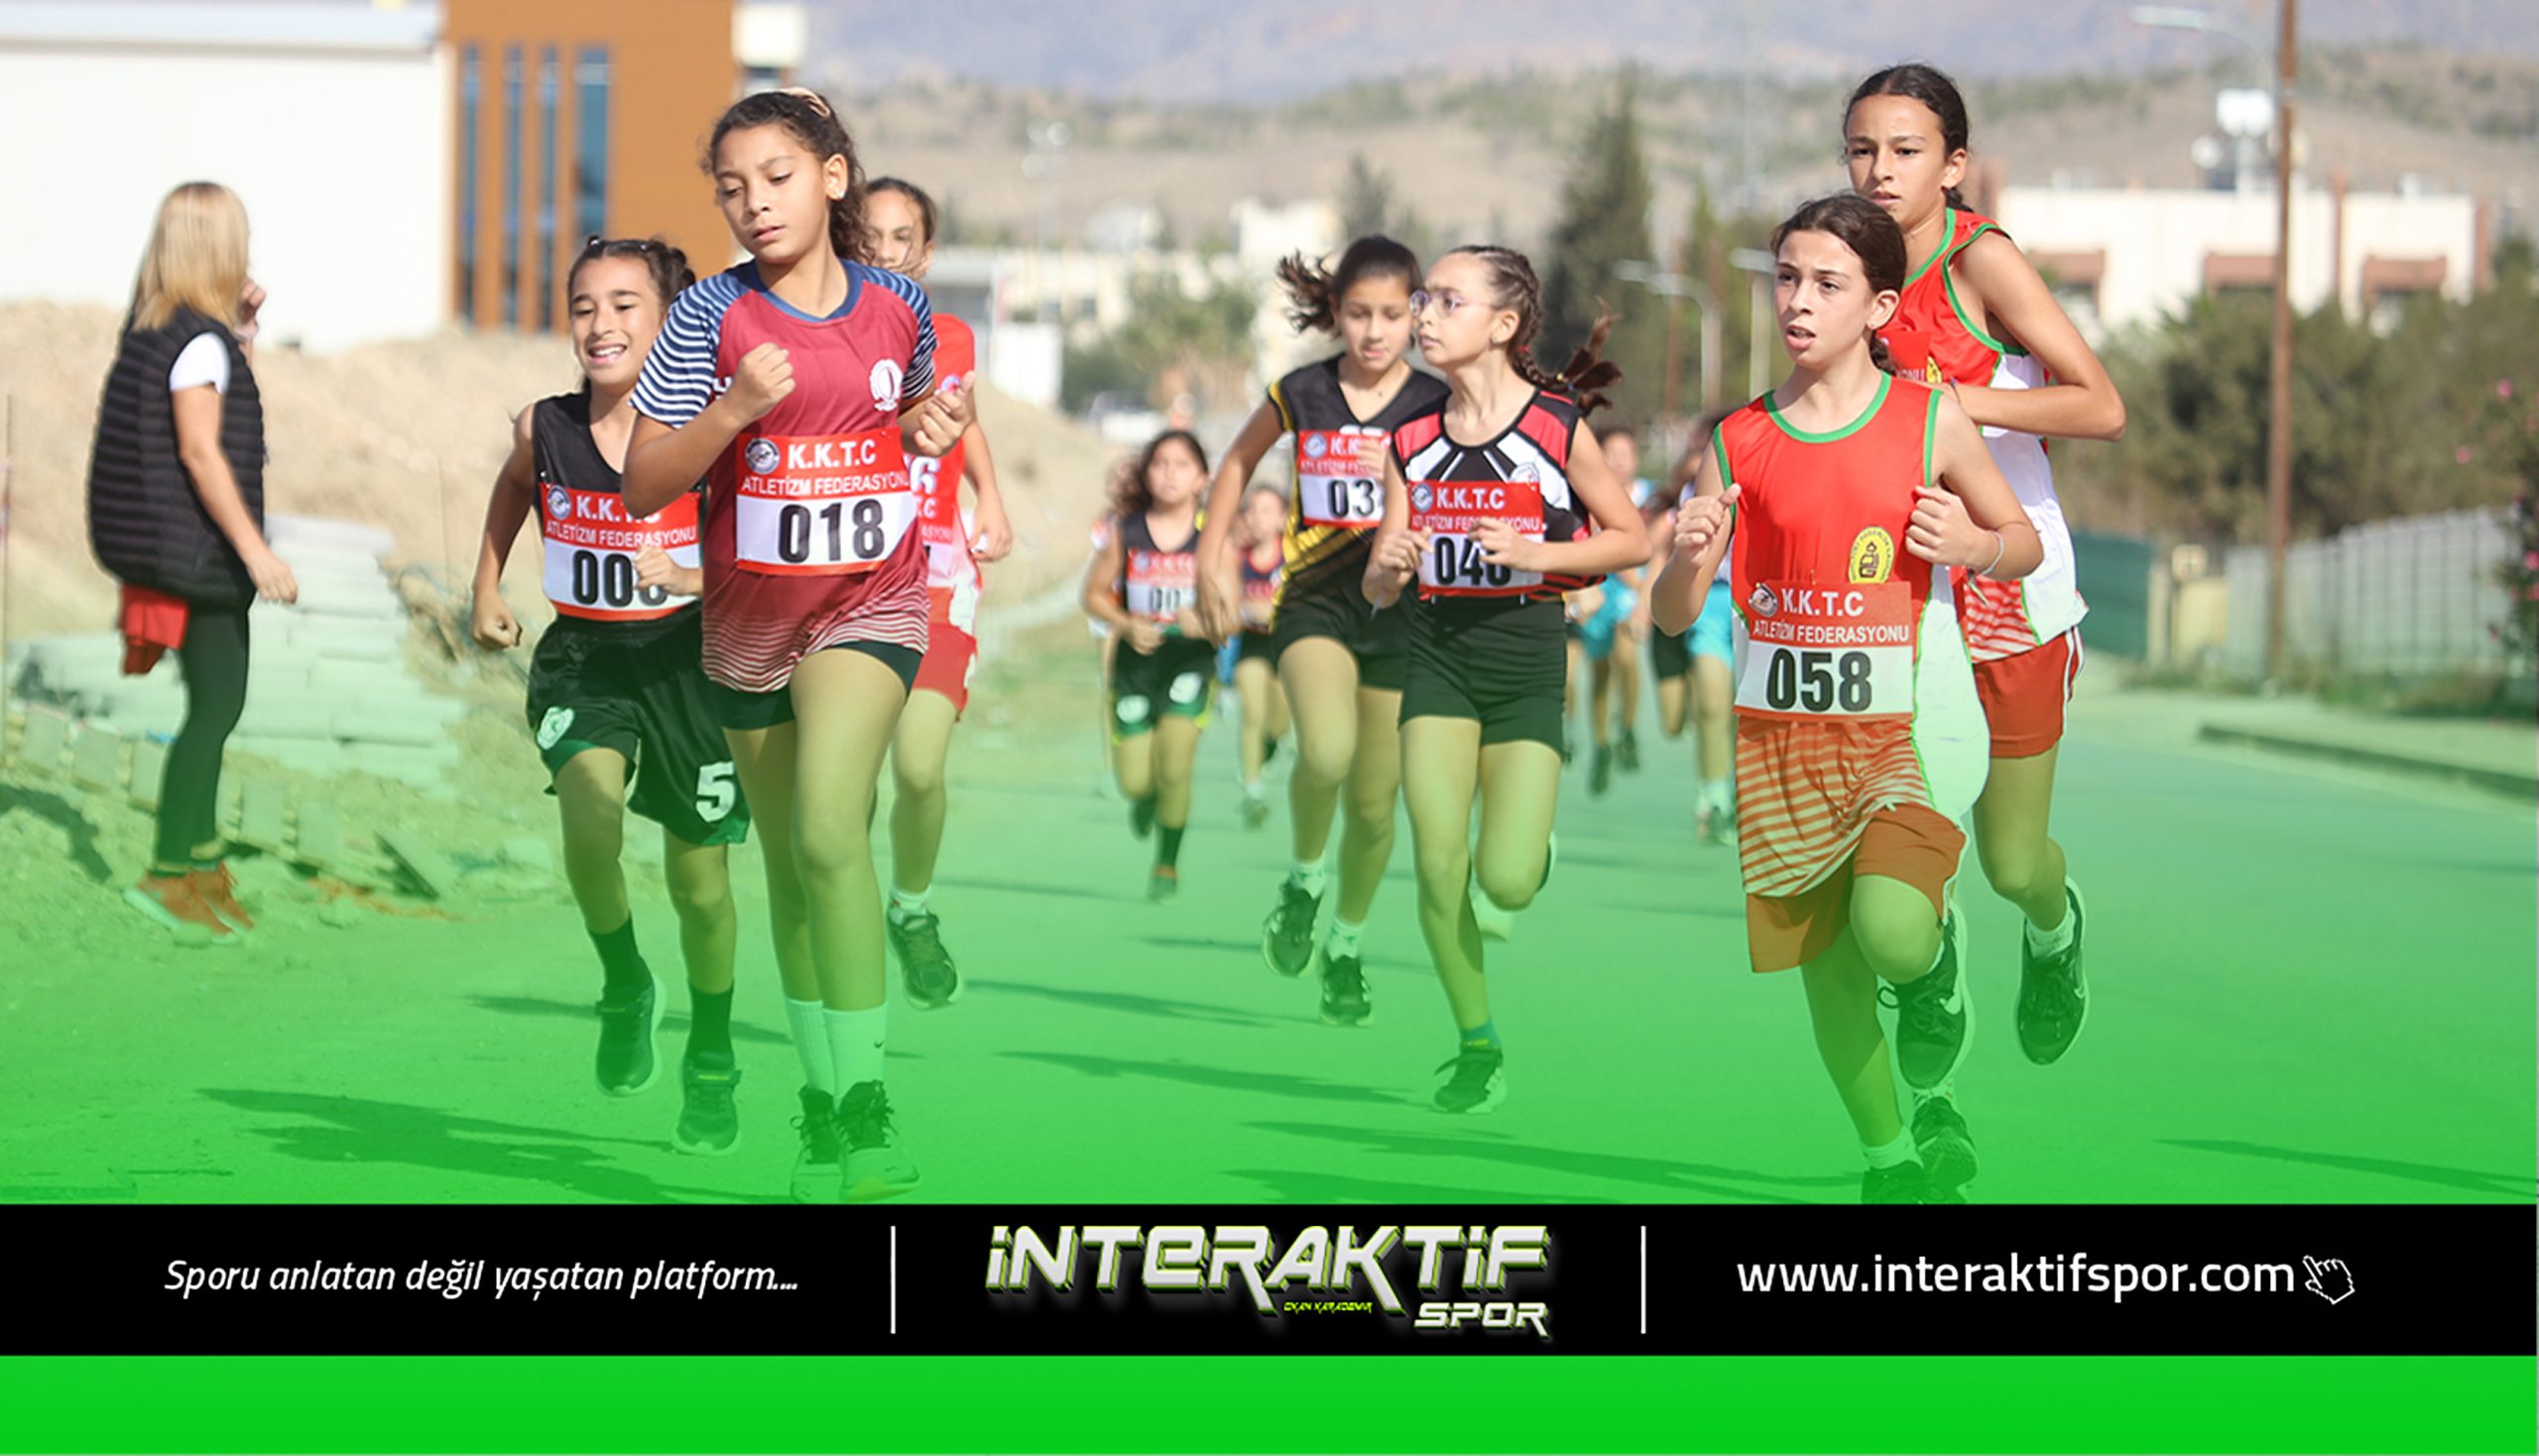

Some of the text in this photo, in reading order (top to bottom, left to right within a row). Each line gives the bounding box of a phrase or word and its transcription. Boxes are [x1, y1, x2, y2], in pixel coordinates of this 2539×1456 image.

[787, 438, 877, 470] K.K.T.C
[742, 474, 811, 496] ATLETİZM
[1328, 479, 1376, 518] 03
[1437, 487, 1506, 510] K.K.T.C
[599, 526, 696, 546] FEDERASYONU
[778, 498, 885, 563] 018
[1781, 588, 1865, 616] K.K.T.C
[1797, 625, 1909, 643] FEDERASYONU
[1765, 648, 1873, 712] 058
[695, 761, 735, 822] 5
